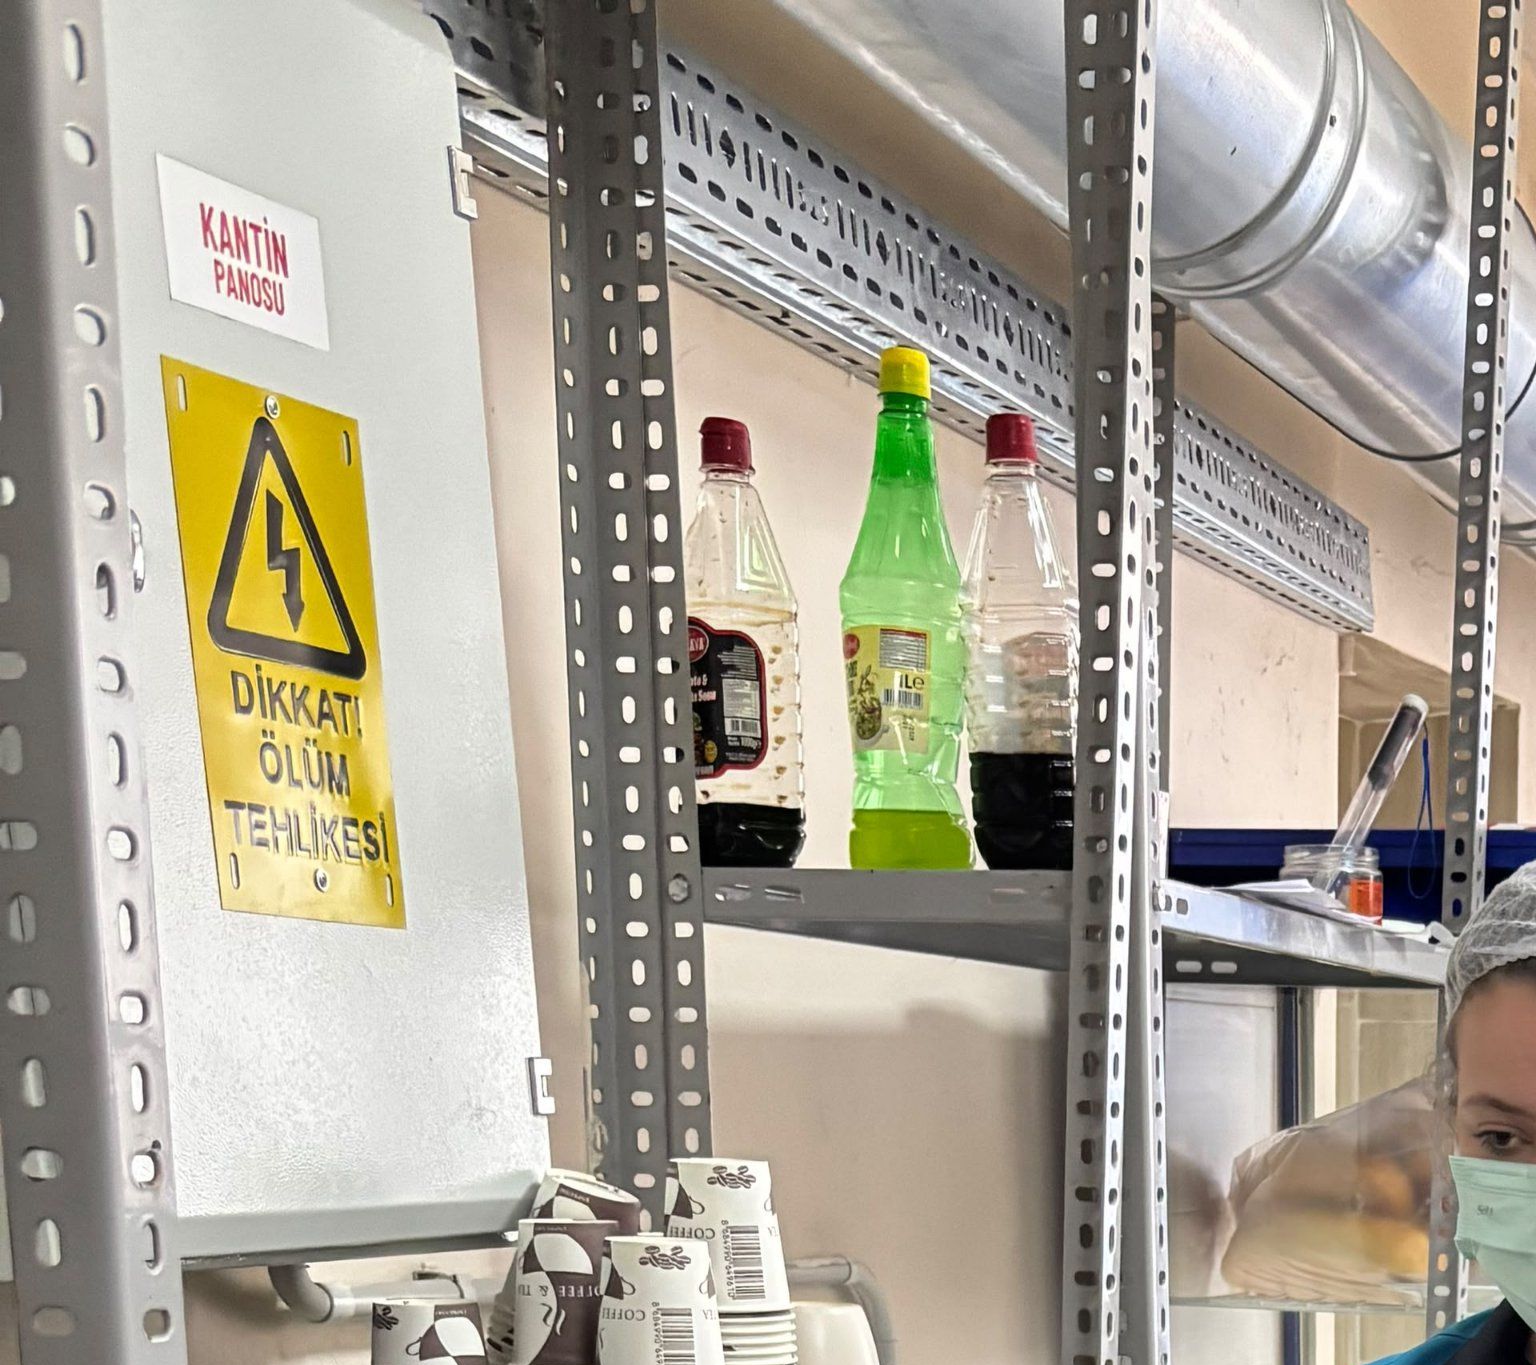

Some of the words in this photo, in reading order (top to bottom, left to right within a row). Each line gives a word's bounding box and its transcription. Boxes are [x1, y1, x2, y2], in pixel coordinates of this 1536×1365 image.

[199, 202, 289, 279] KANTİN
[213, 258, 285, 316] PANOSU
[231, 664, 363, 738] DİKKAT!
[259, 729, 351, 797] ÖLÜM
[224, 800, 390, 866] TEHLİKESİ
